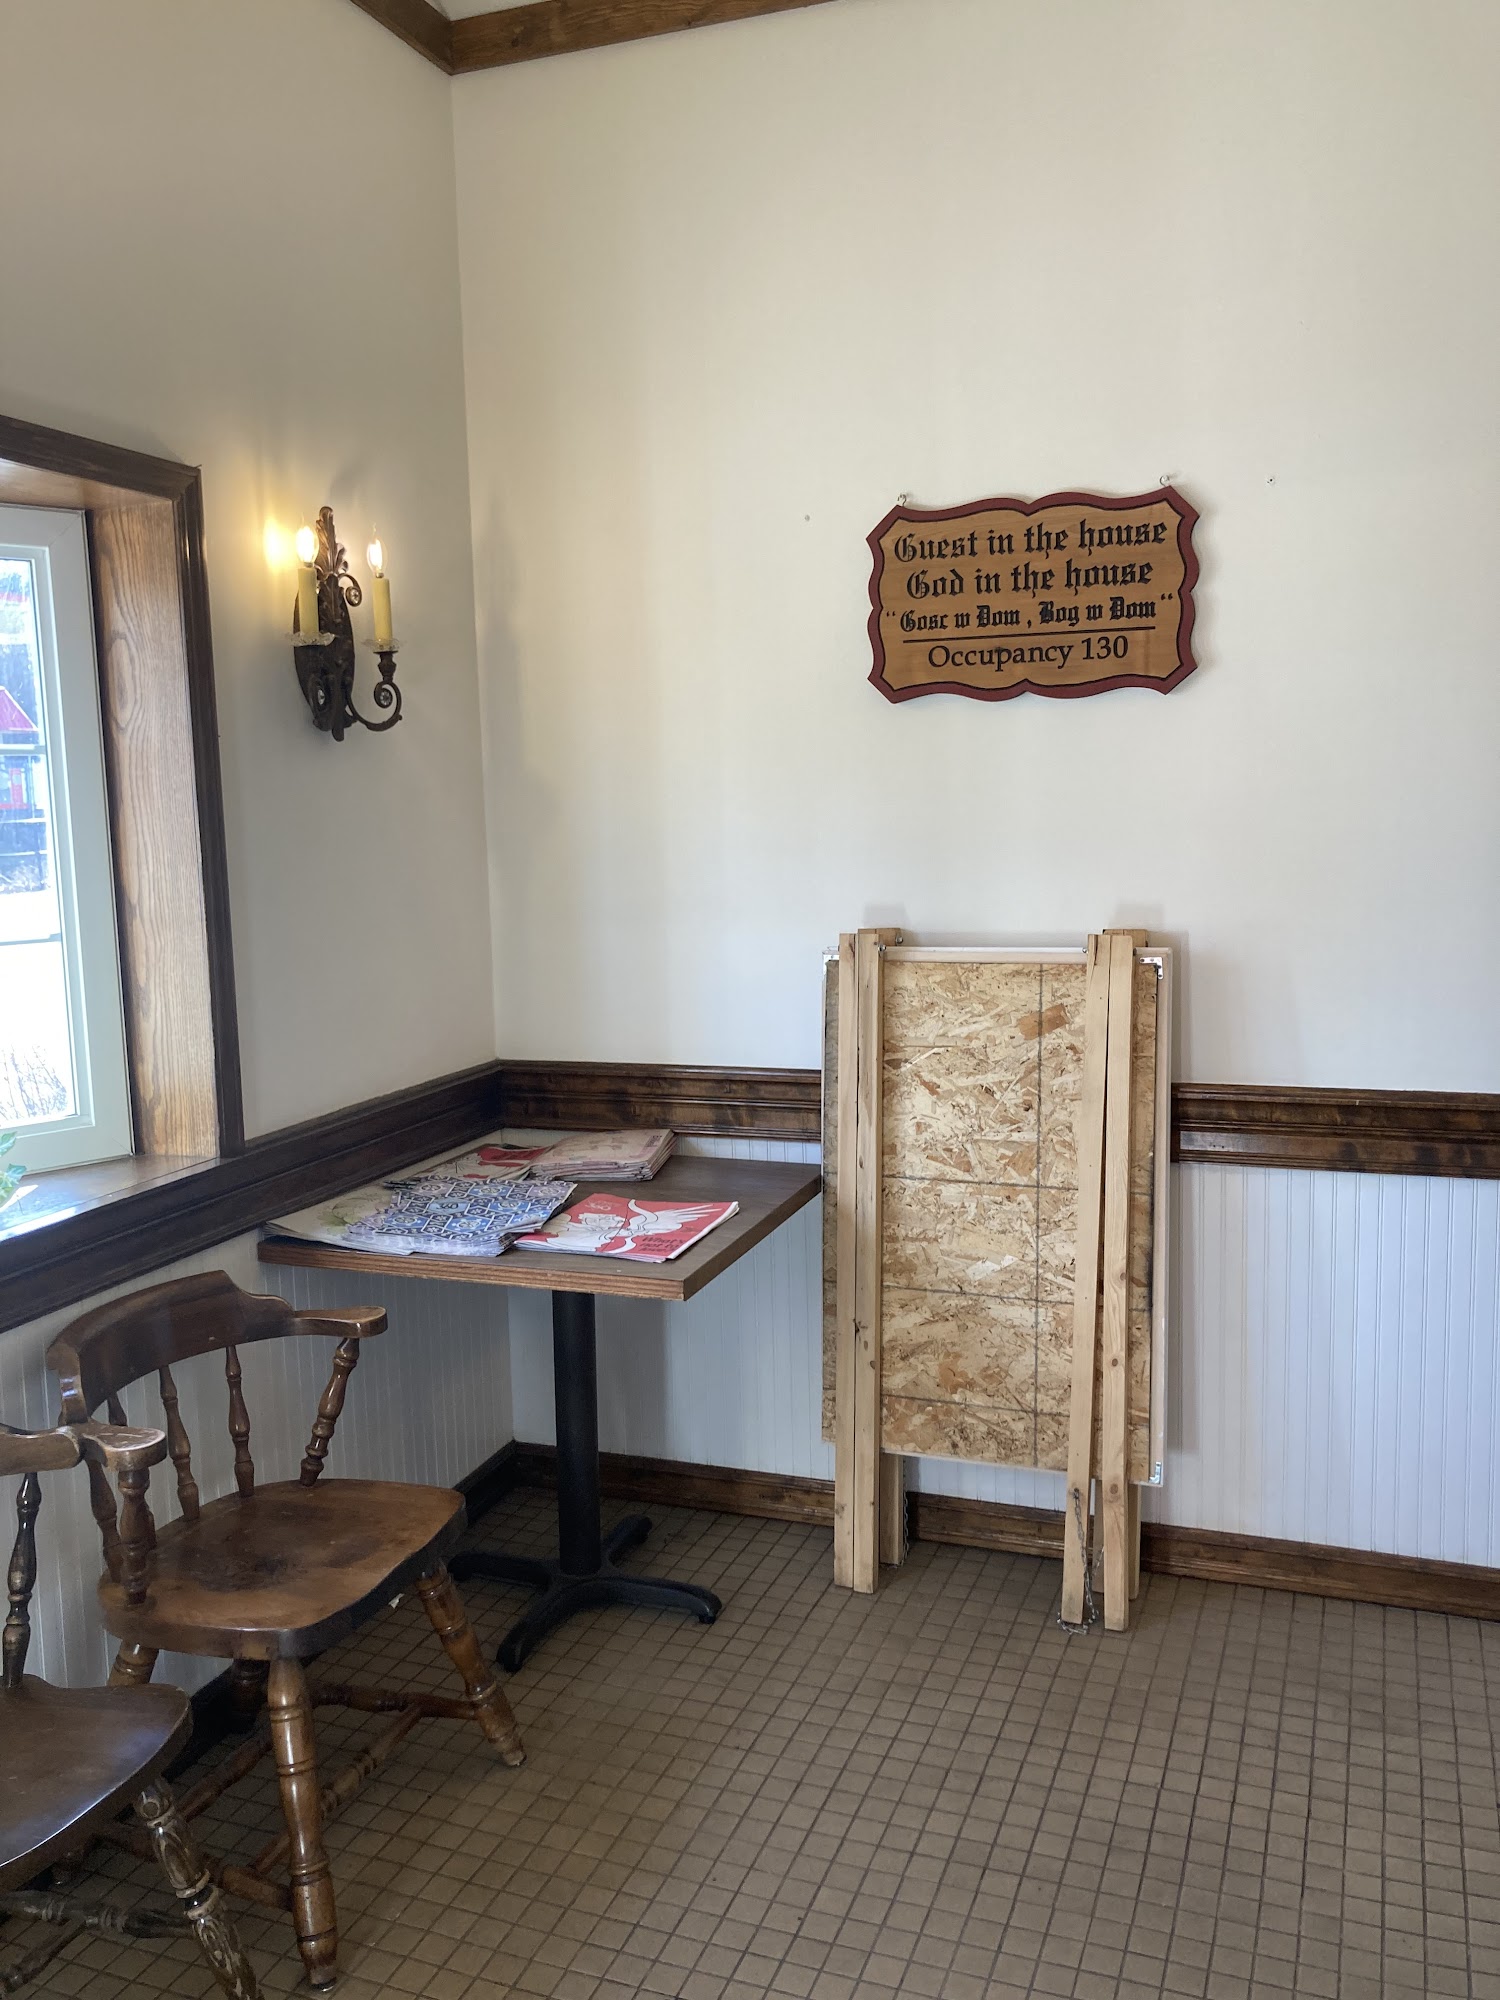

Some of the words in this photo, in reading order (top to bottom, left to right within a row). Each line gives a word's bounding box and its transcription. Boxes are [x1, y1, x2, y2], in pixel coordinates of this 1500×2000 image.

[894, 531, 978, 562] Guest
[987, 529, 1015, 555] in
[1024, 522, 1069, 559] the
[1078, 518, 1168, 556] house
[907, 568, 964, 599] God
[974, 568, 1001, 594] in
[1011, 561, 1055, 599] the
[1065, 558, 1154, 596] house
[1038, 600, 1079, 627] Bog
[928, 644, 1074, 672] Occupancy
[1081, 635, 1129, 660] 130
